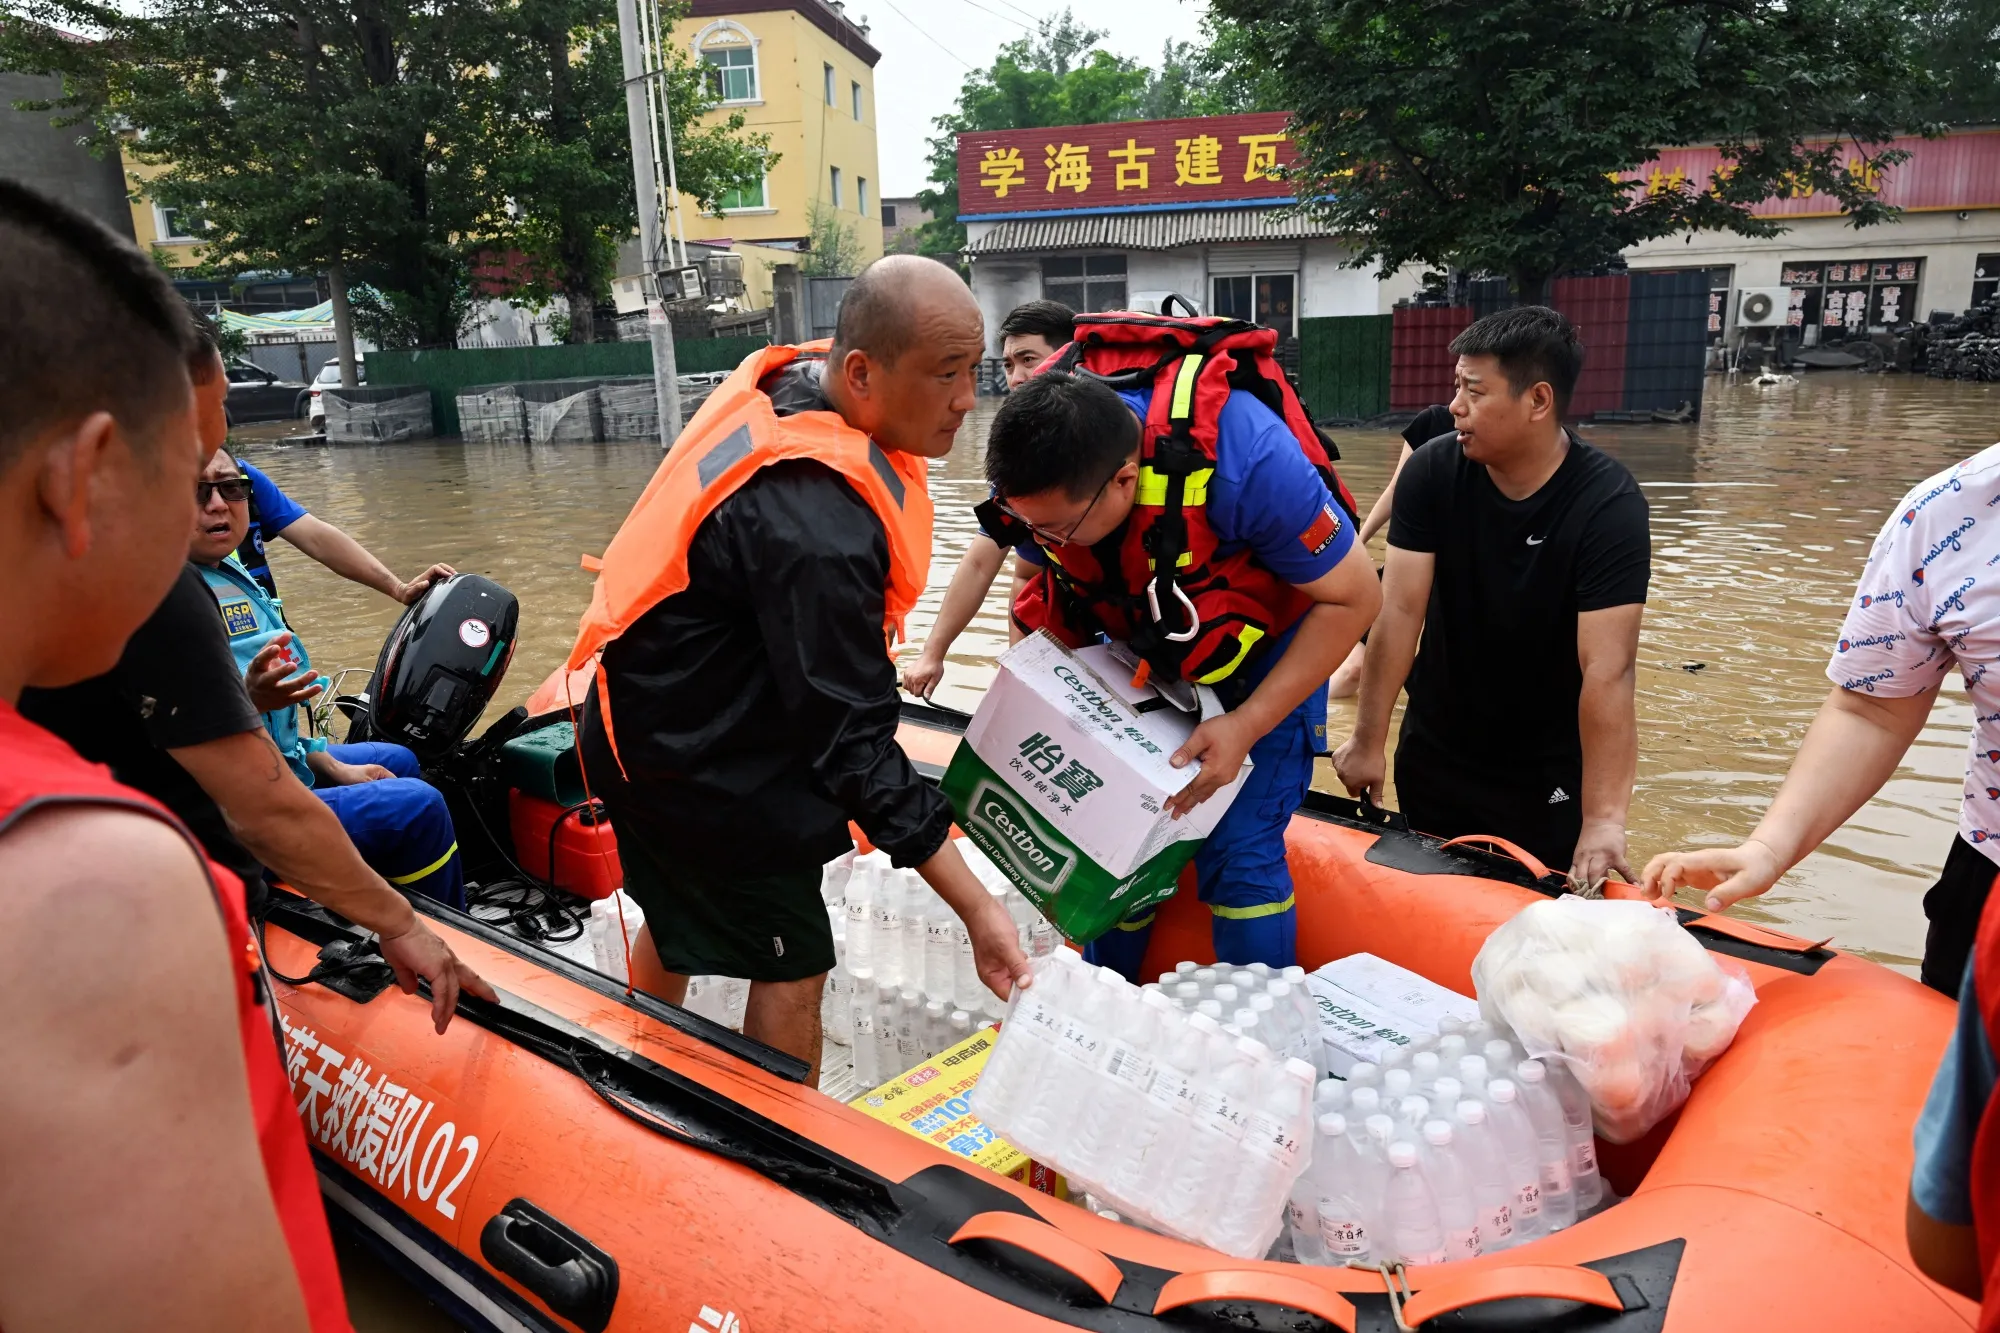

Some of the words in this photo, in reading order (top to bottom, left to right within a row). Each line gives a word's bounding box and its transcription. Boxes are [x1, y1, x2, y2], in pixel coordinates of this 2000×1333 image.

[979, 134, 1354, 198] 学海古建瓦
[1314, 543, 1327, 554] 中国
[1325, 522, 1342, 545] CHINA
[1008, 757, 1073, 817] 饮用纯净水
[1548, 795, 1570, 804] adidas
[964, 820, 993, 852] Purified
[991, 846, 1020, 882] Drinking
[1018, 878, 1045, 904] Water
[942, 1038, 992, 1067] 电商版
[948, 1072, 982, 1096] 上市以
[1334, 1228, 1364, 1241] 凉白开
